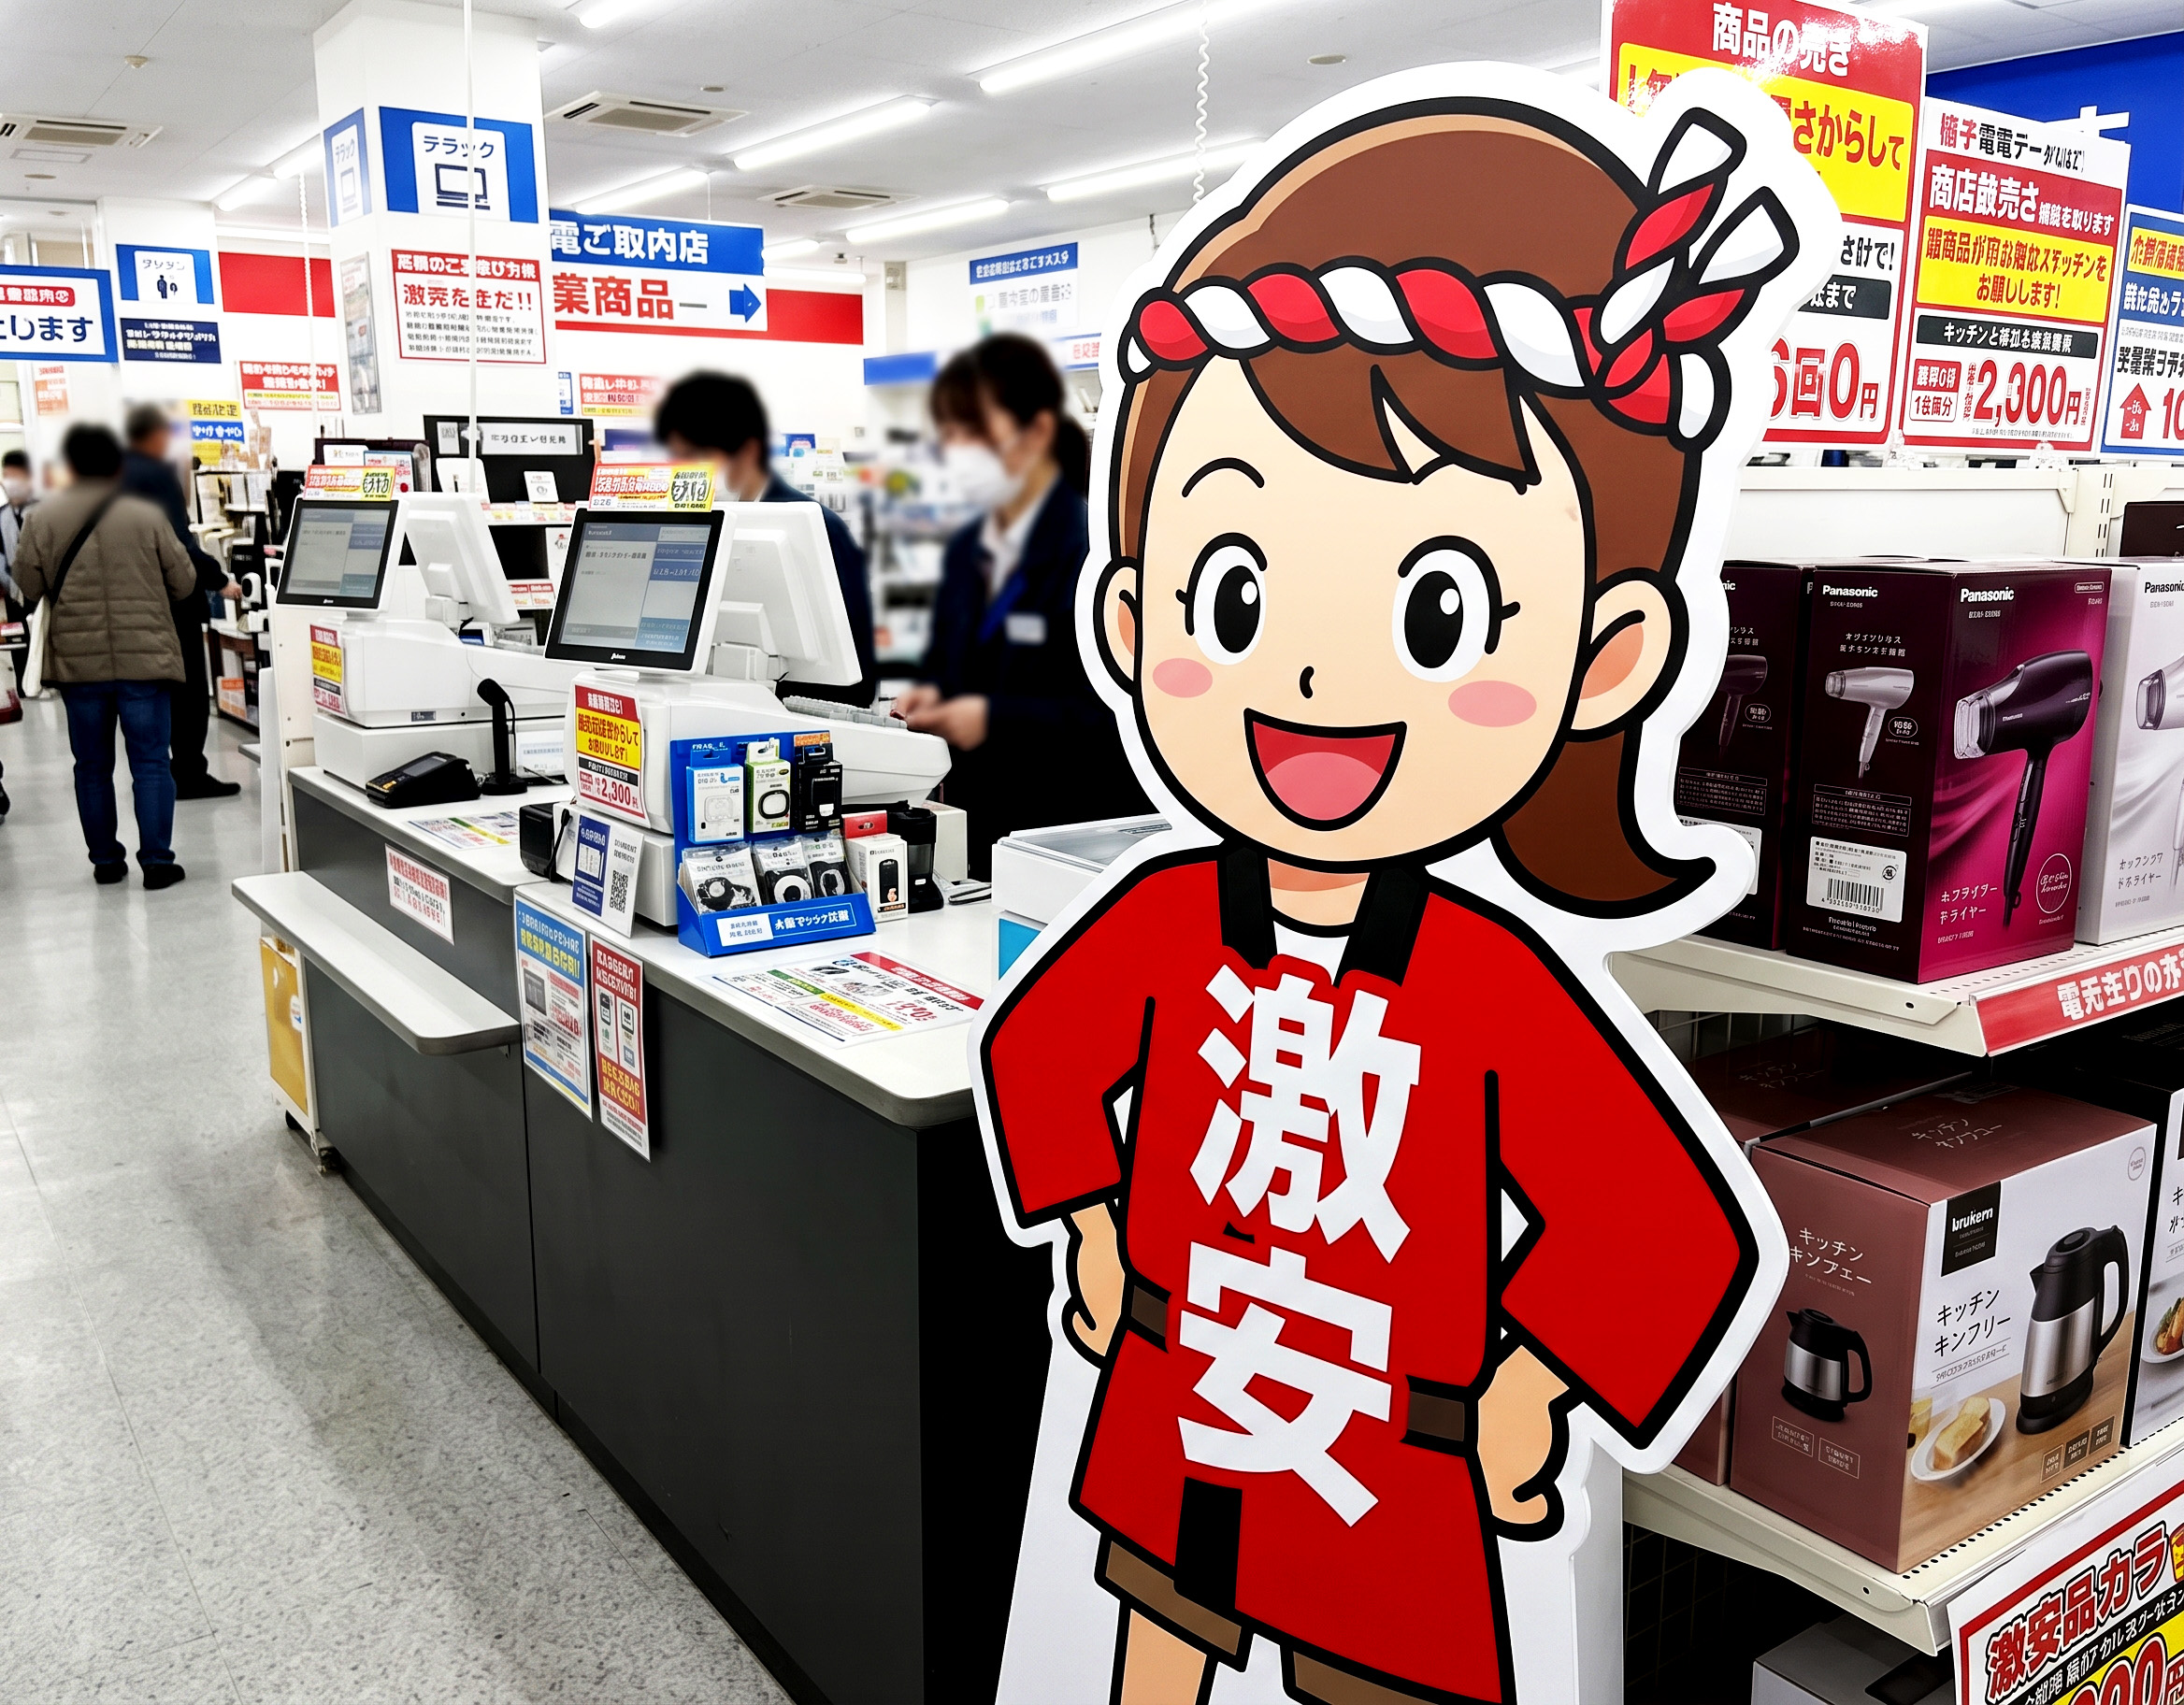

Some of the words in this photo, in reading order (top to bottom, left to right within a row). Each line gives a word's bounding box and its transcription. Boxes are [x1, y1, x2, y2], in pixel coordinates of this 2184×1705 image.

[1771, 94, 1904, 171] さからして
[1822, 584, 1878, 598] Panasonic
[1960, 586, 2015, 603] Panasonic
[1178, 964, 1422, 1527] 激安
[1799, 1227, 1863, 1261] キッチン
[1937, 1289, 2000, 1326] キッチン
